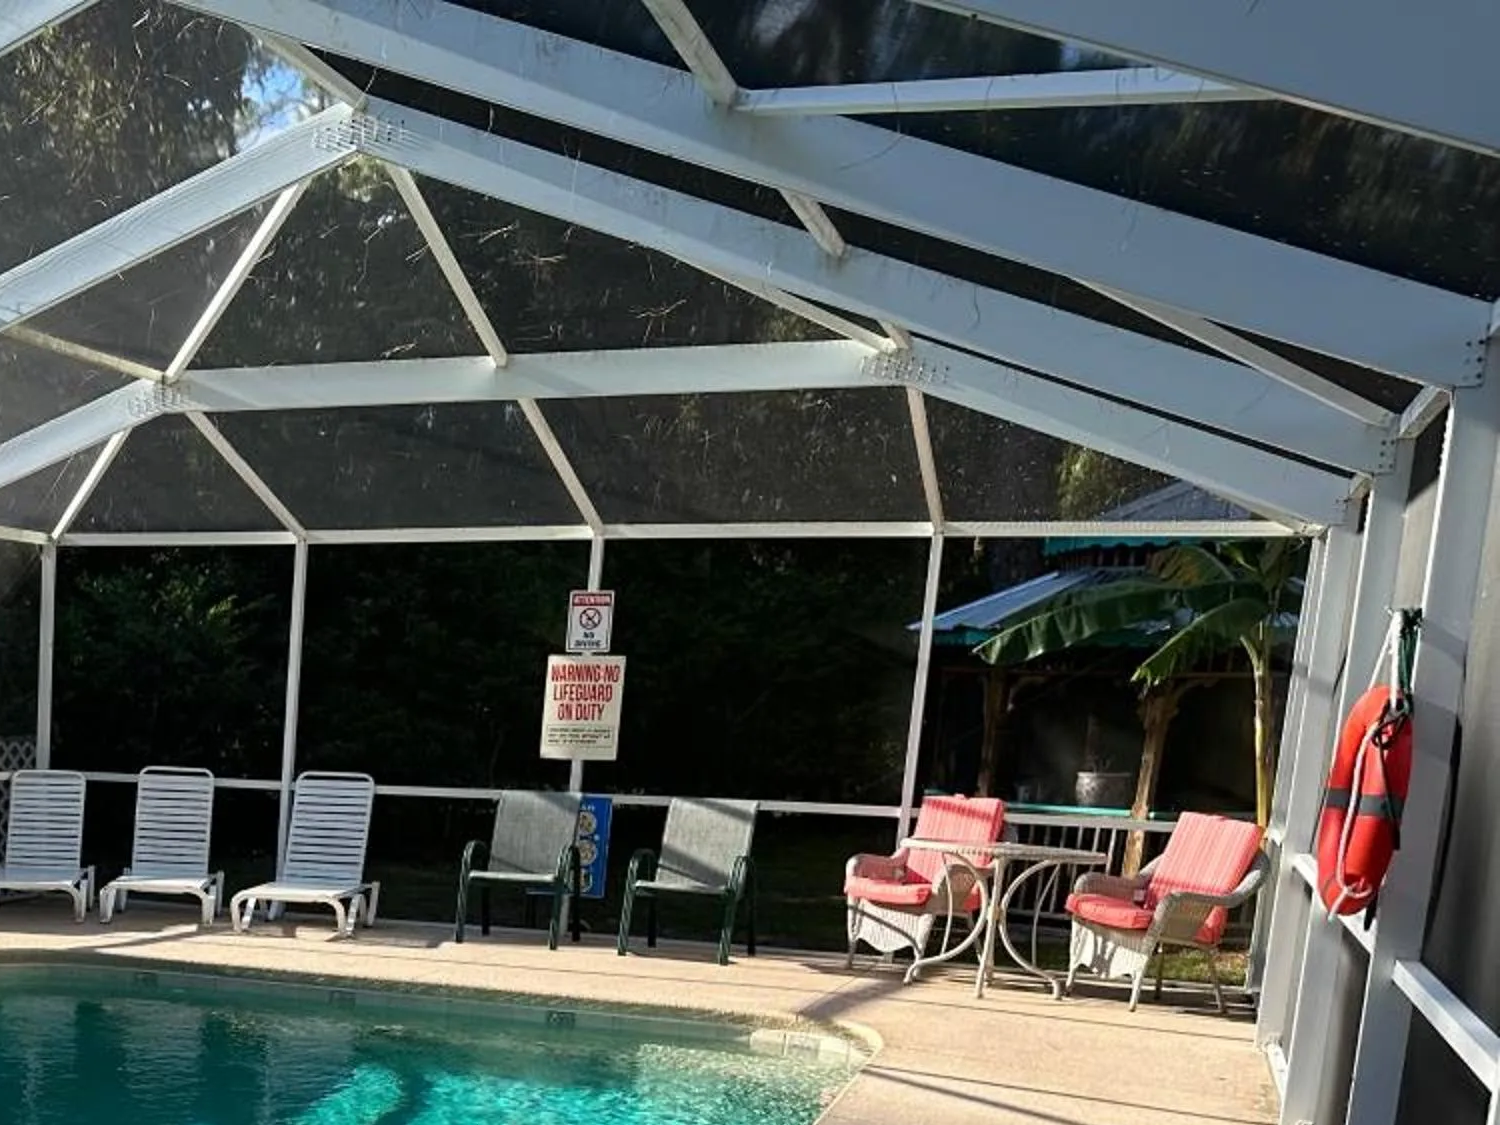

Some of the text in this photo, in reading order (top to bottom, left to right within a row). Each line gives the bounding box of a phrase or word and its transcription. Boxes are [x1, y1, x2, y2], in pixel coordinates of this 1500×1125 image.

[603, 664, 621, 683] NO
[553, 683, 613, 702] LIFEGUARD
[557, 703, 605, 721] ON DUTY
